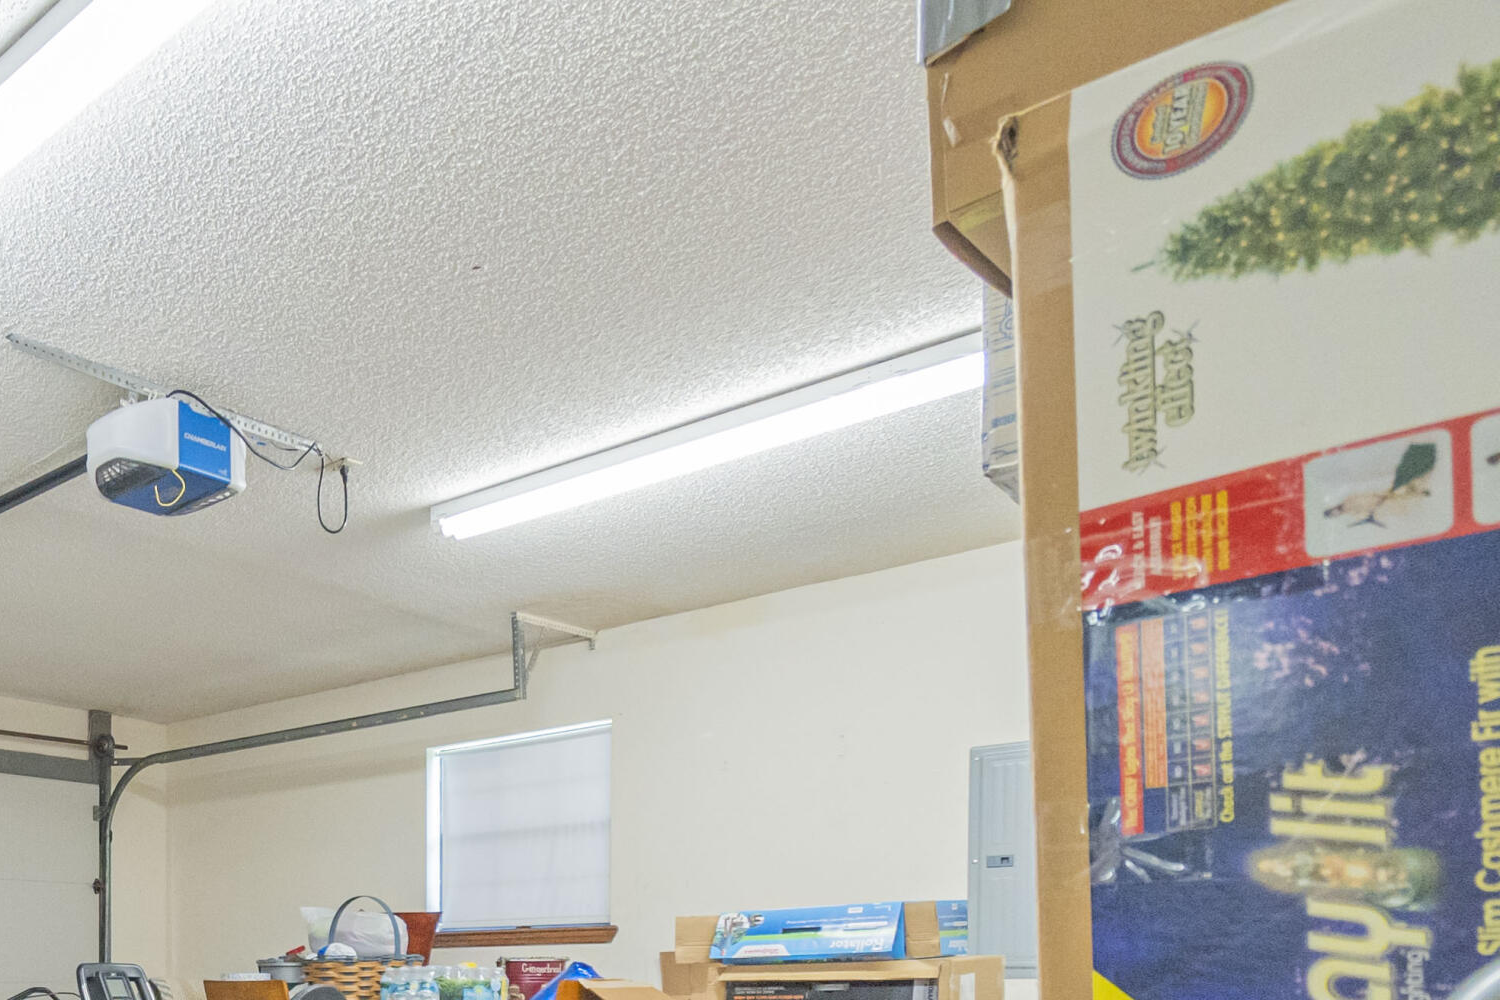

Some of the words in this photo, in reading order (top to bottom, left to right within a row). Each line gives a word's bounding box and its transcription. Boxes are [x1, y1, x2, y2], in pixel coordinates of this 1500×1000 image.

[1117, 310, 1165, 473] twinkling
[1155, 335, 1195, 428] effect
[1469, 645, 1500, 705] with
[1470, 709, 1500, 742] Fir
[1269, 760, 1390, 846] lit
[1474, 746, 1500, 892] Cashmere
